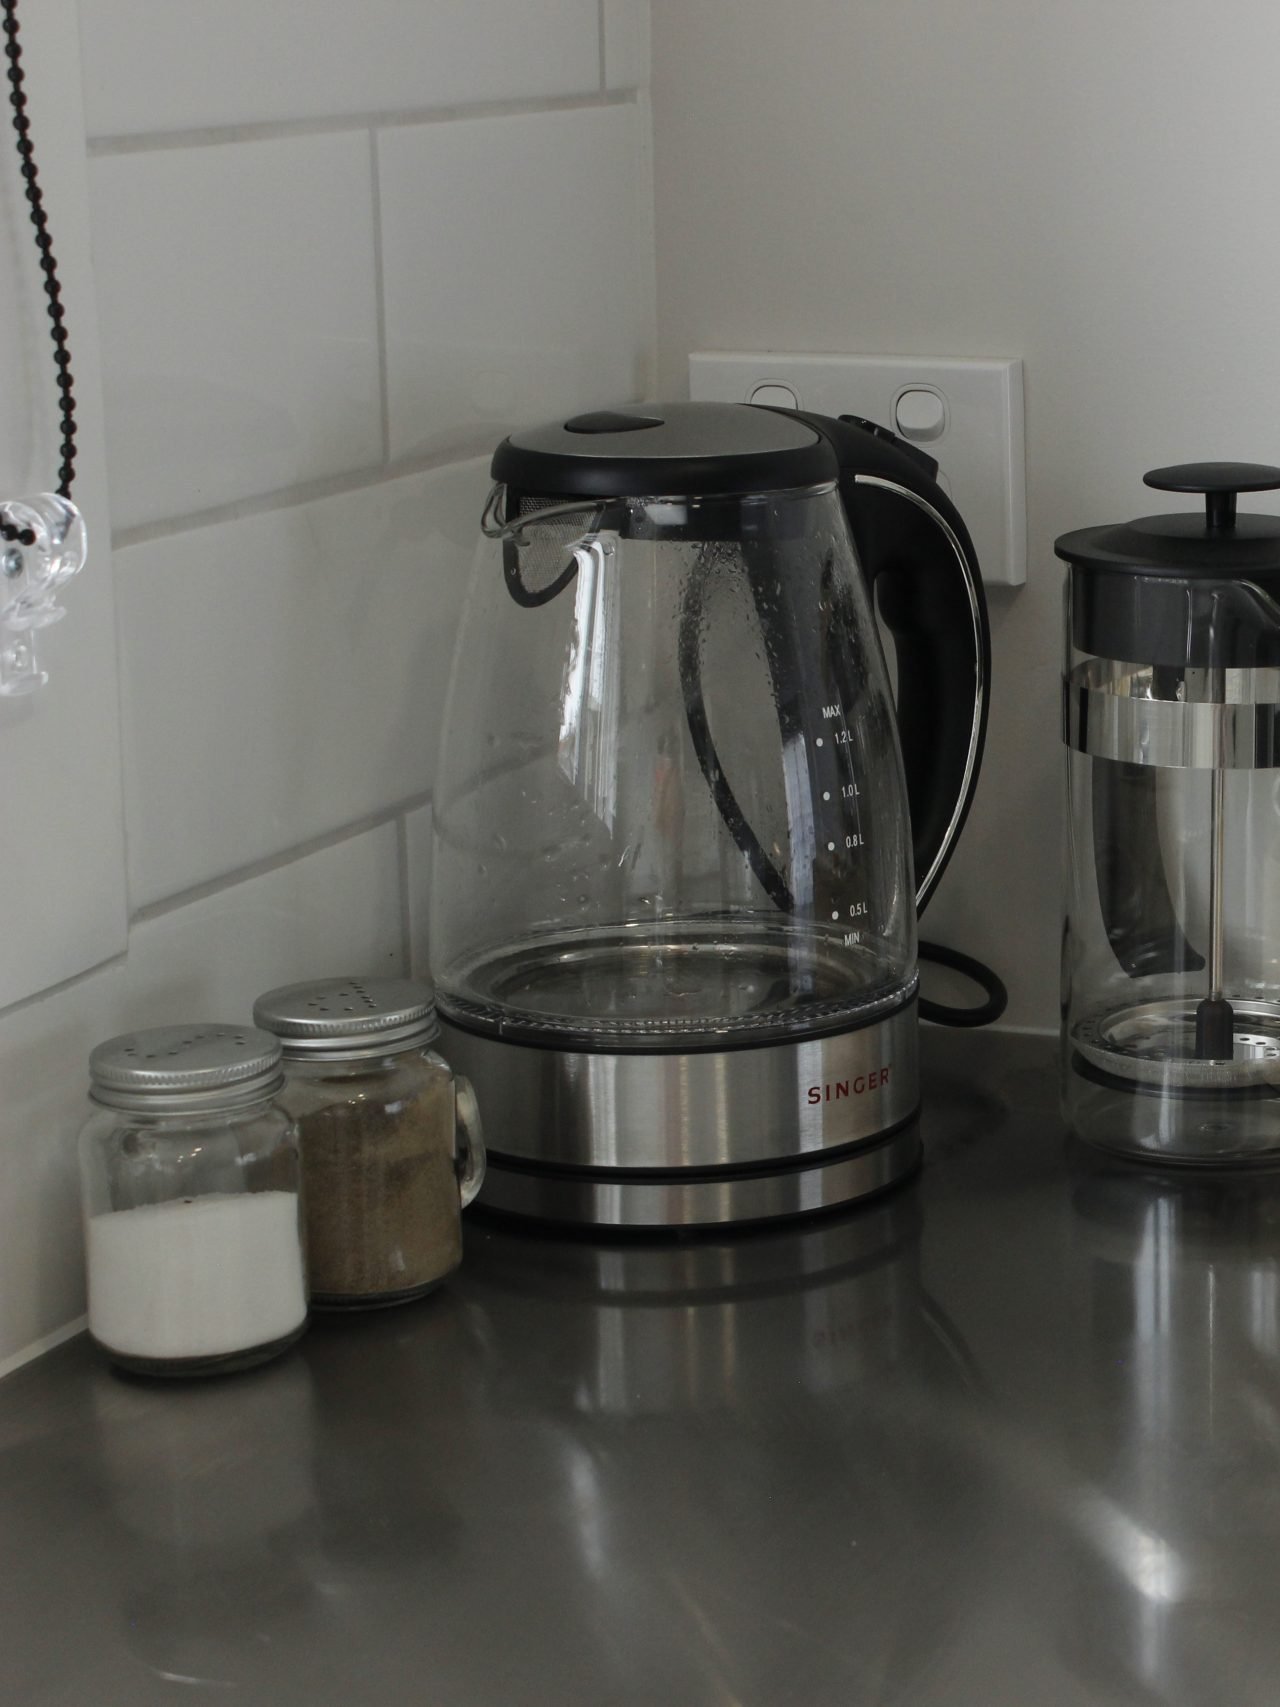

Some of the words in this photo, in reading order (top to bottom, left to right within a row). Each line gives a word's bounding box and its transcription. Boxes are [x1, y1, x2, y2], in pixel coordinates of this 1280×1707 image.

[822, 704, 841, 719] MAX
[844, 931, 860, 947] MIN
[807, 1067, 890, 1105] SINGER
